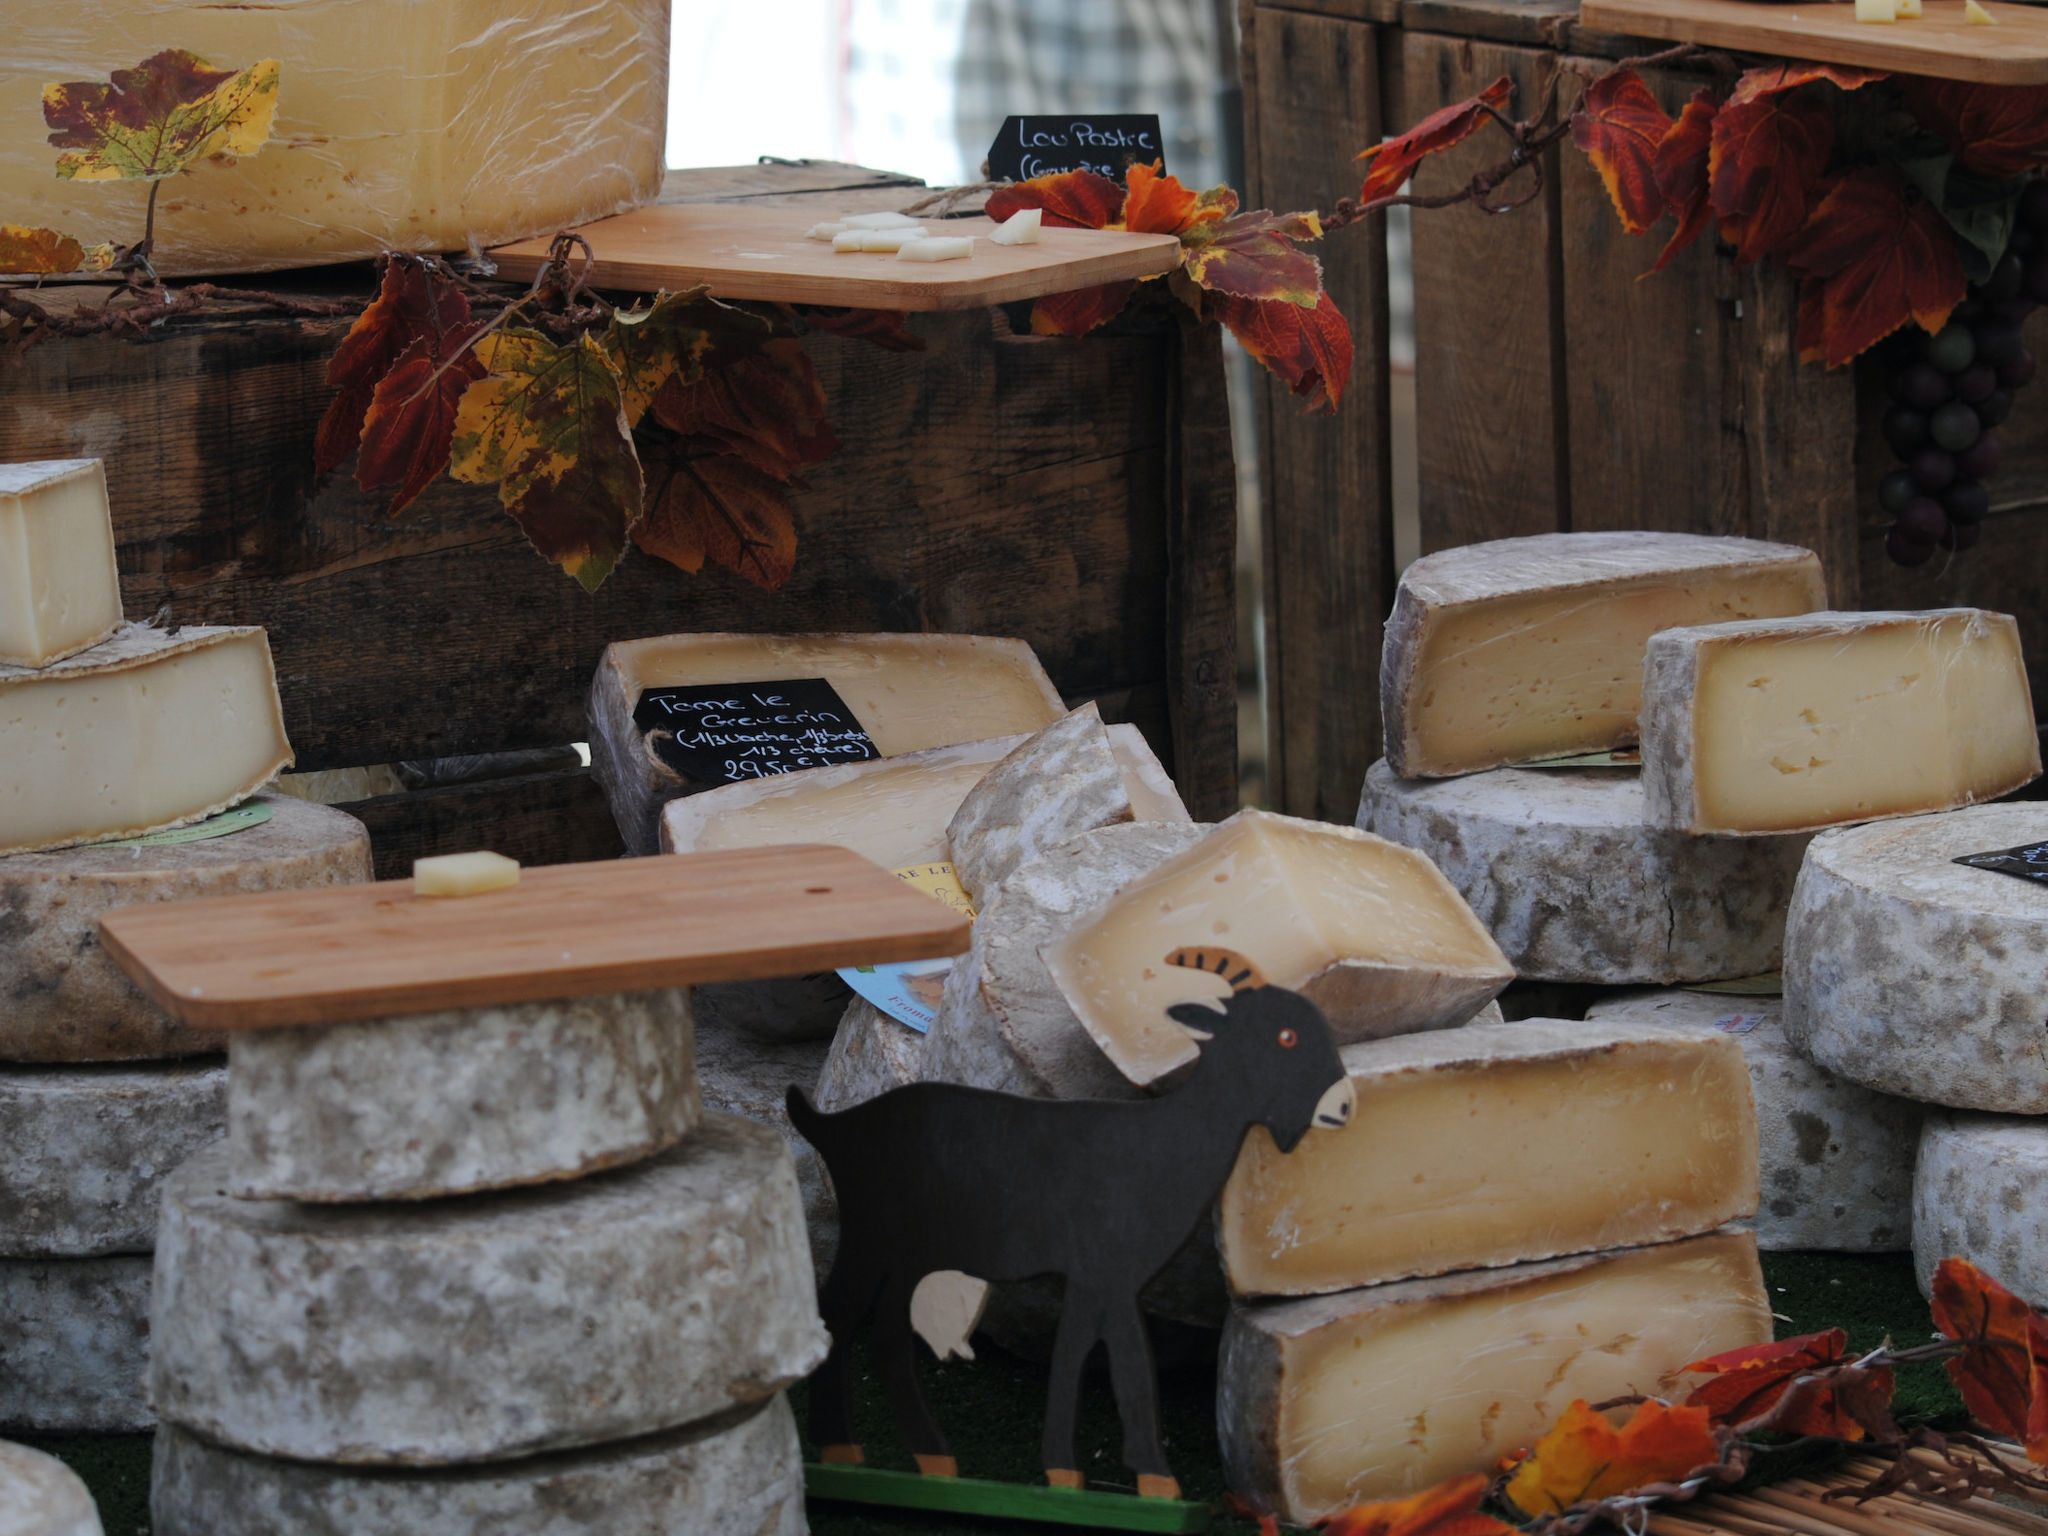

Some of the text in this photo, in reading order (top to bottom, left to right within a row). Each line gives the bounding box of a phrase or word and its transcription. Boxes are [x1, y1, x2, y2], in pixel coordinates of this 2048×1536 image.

[1019, 118, 1154, 149] Lou Pastre
[1020, 153, 1115, 182] (Gruère
[649, 692, 790, 714] Tome le
